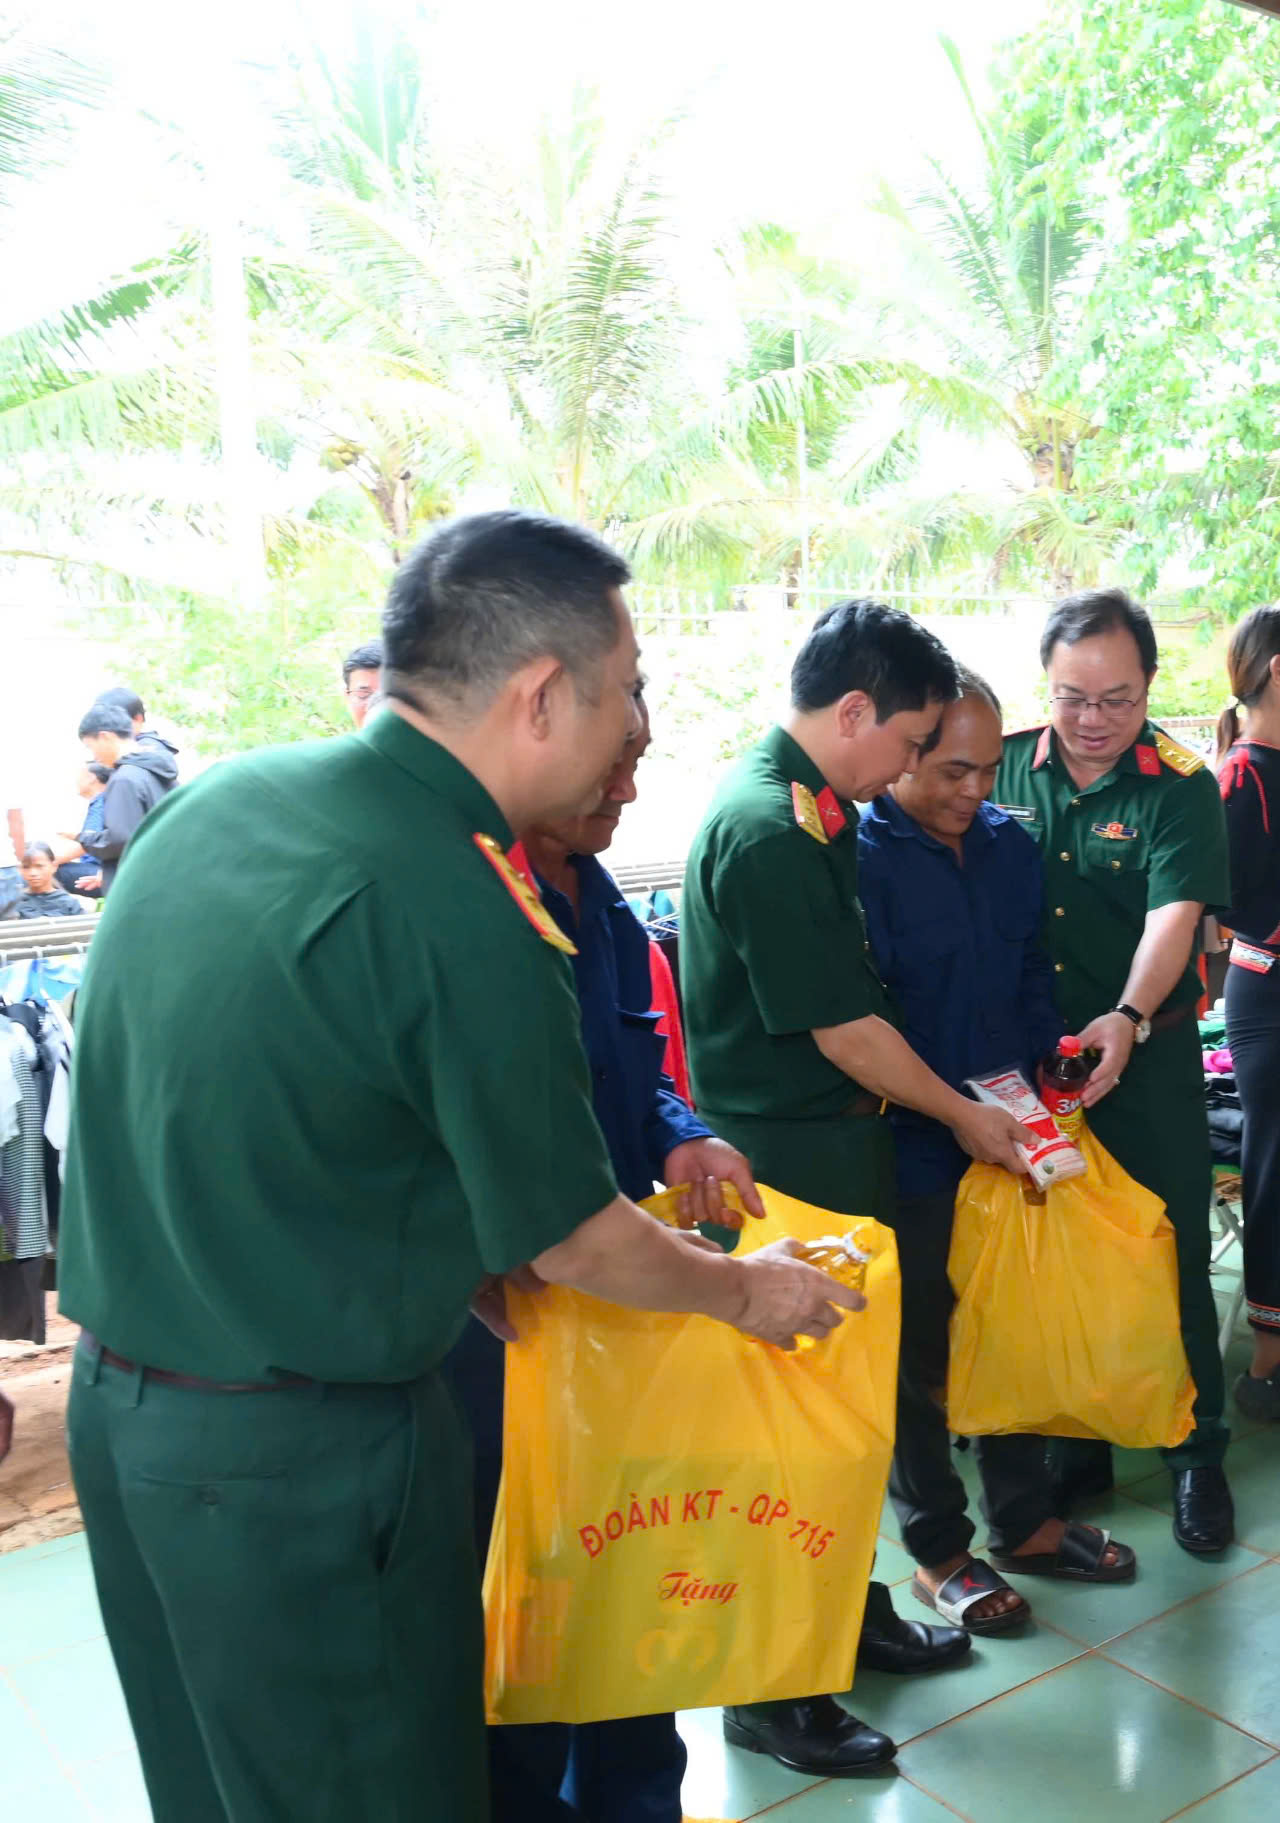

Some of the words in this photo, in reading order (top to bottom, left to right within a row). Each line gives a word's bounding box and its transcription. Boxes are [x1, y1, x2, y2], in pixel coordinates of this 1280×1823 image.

[578, 1492, 671, 1560] ĐOÀN
[681, 1489, 724, 1523] KT
[747, 1492, 790, 1528] QP
[788, 1518, 837, 1560] 715
[657, 1570, 741, 1607] Tặng
